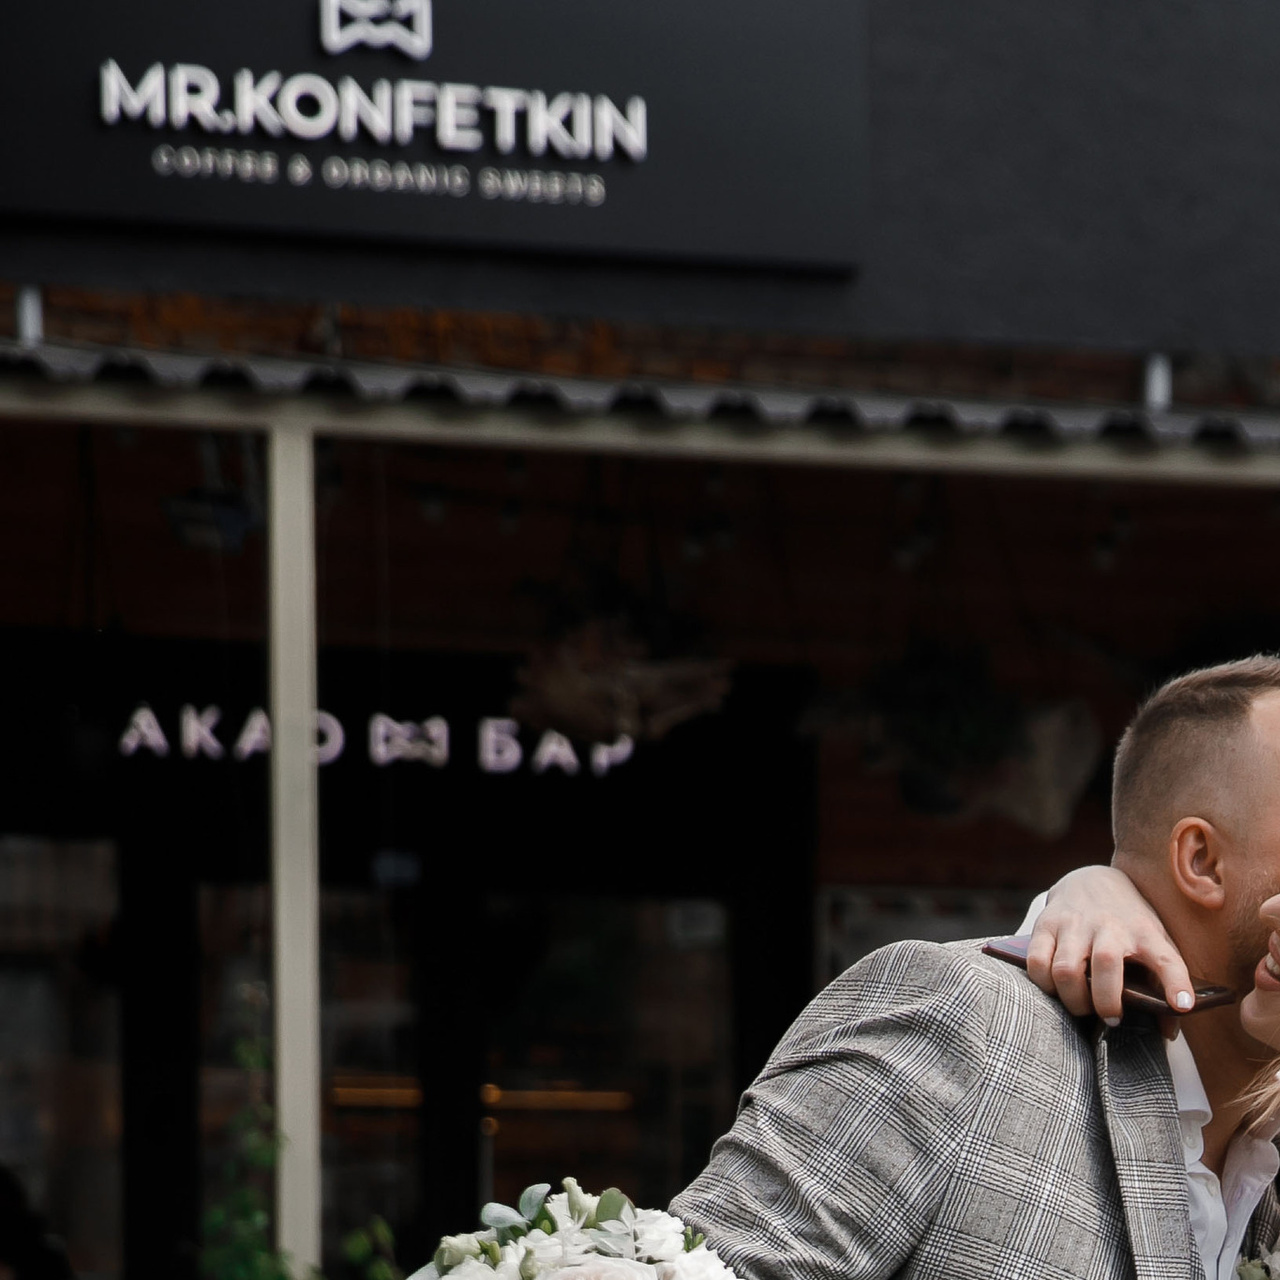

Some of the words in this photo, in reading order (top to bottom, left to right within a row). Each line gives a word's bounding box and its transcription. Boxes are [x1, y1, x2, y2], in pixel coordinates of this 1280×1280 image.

[101, 59, 647, 160] MR.KONFETKIN
[153, 145, 278, 184] COFFEE
[322, 155, 470, 197] ORGANIC
[478, 167, 606, 206] SWEETS
